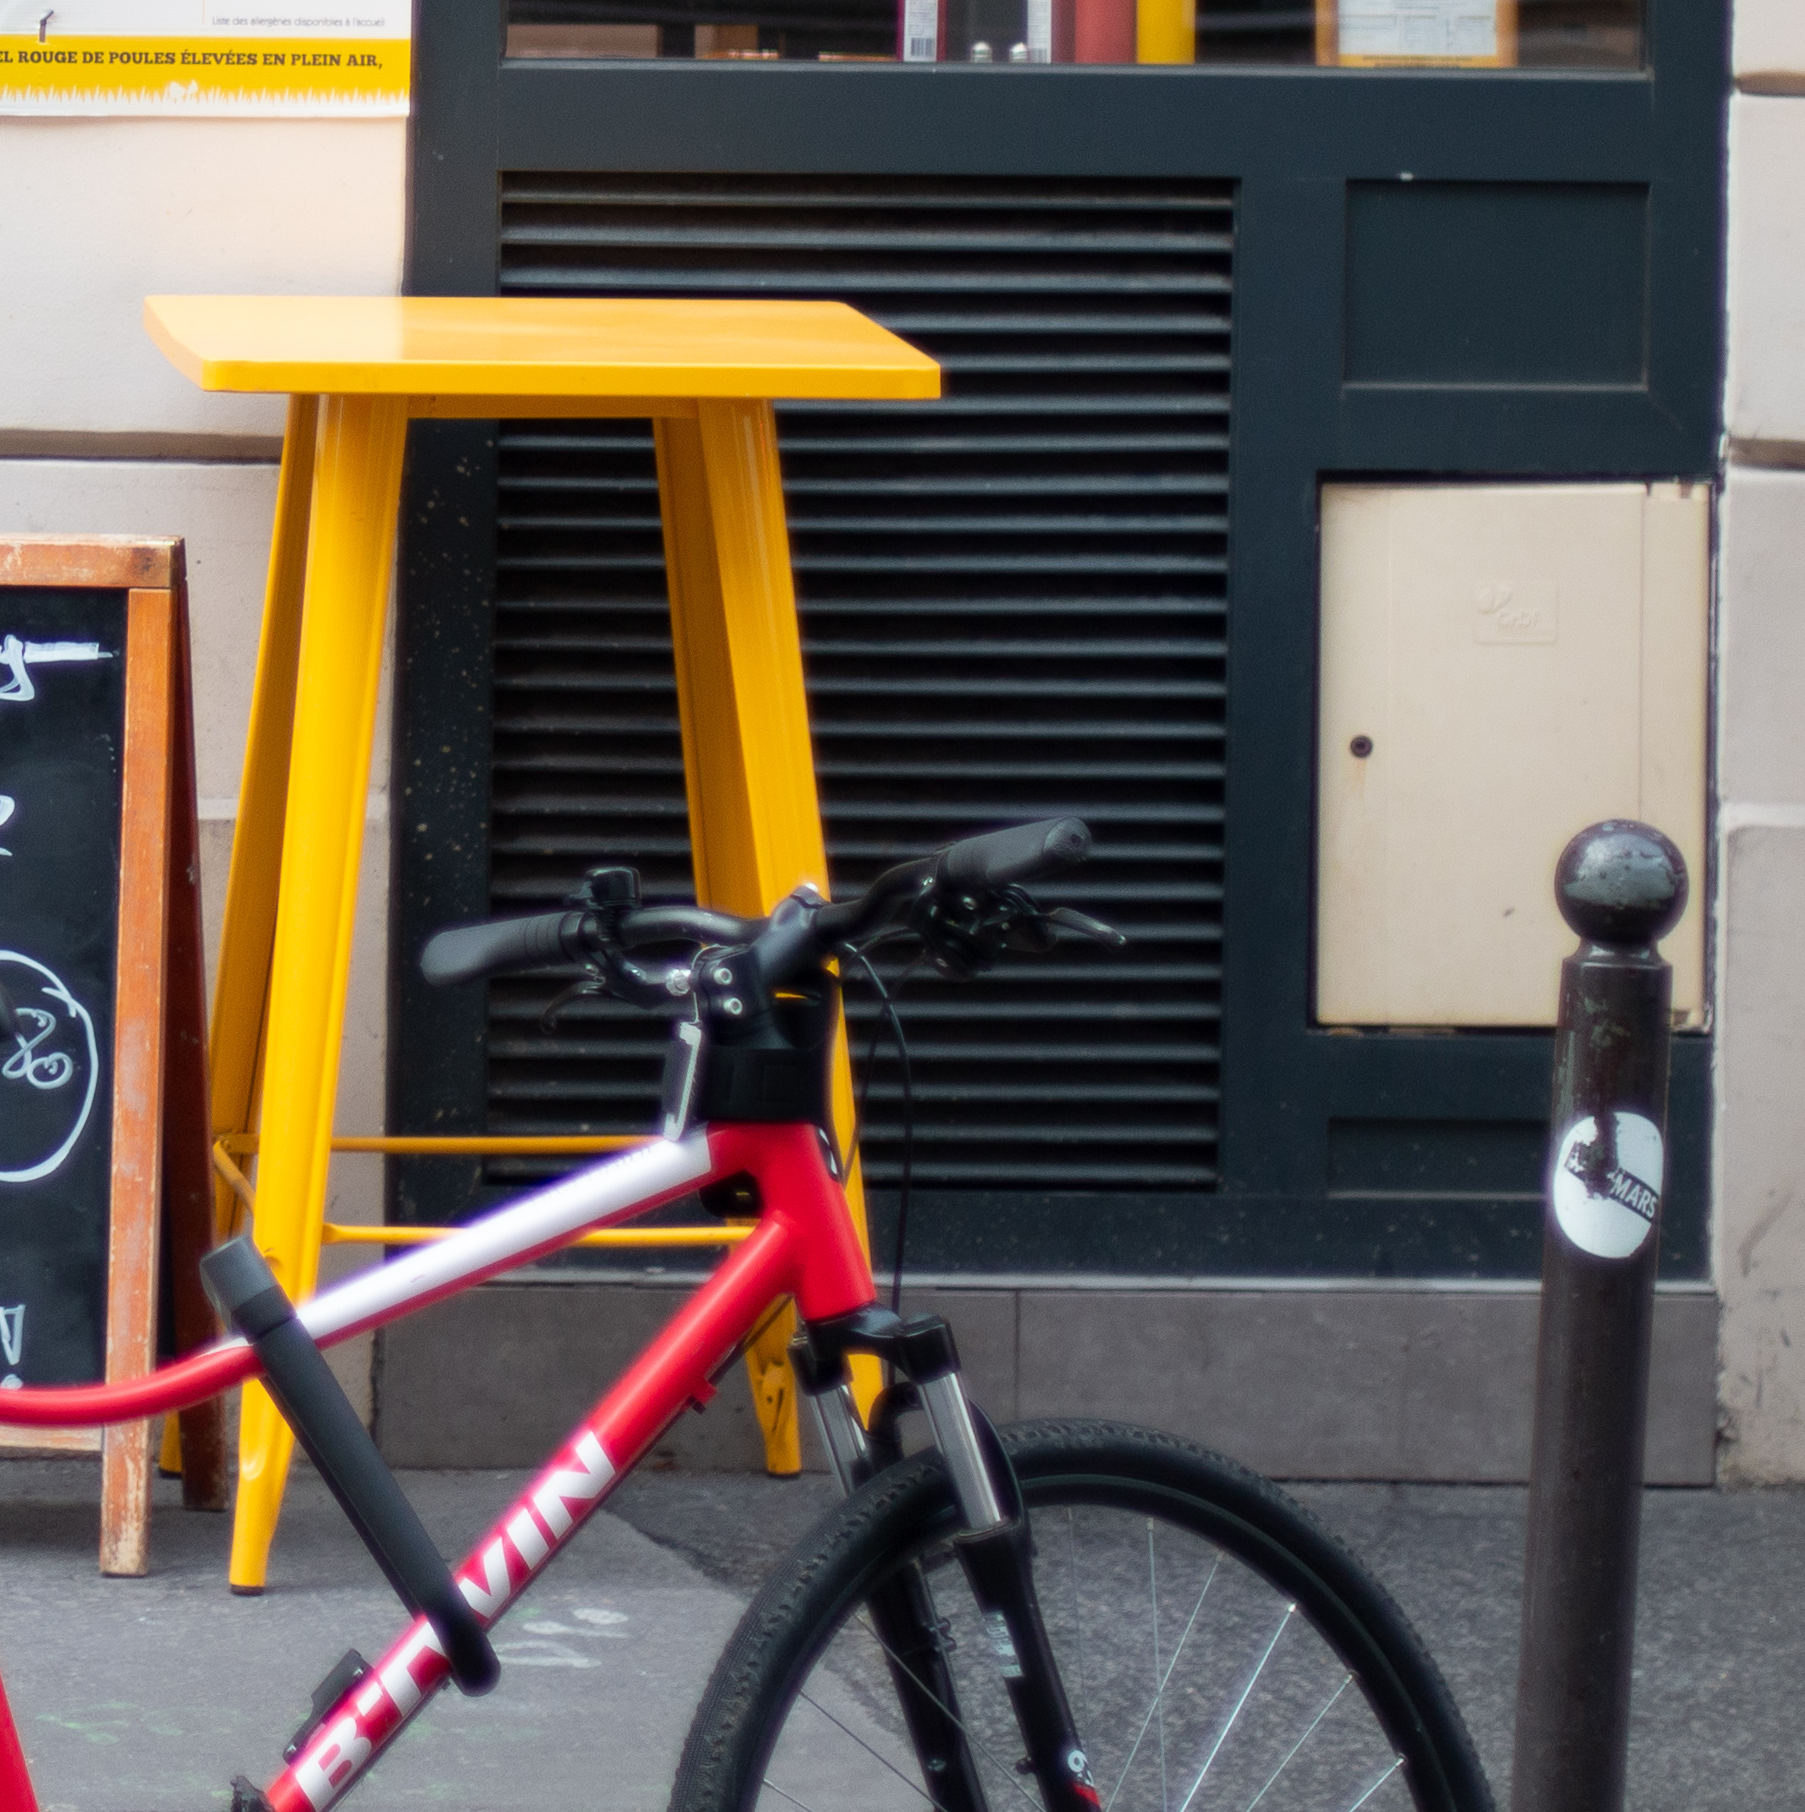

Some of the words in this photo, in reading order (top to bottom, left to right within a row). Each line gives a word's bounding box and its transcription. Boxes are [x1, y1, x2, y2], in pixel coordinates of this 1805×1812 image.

[18, 51, 77, 64] ROUGE
[83, 52, 104, 64] DE
[109, 52, 176, 65] POULES
[181, 50, 257, 65] ÉLEVÉES
[263, 54, 286, 66] EN
[291, 54, 341, 66] PLEIN
[347, 54, 383, 69] AIR,
